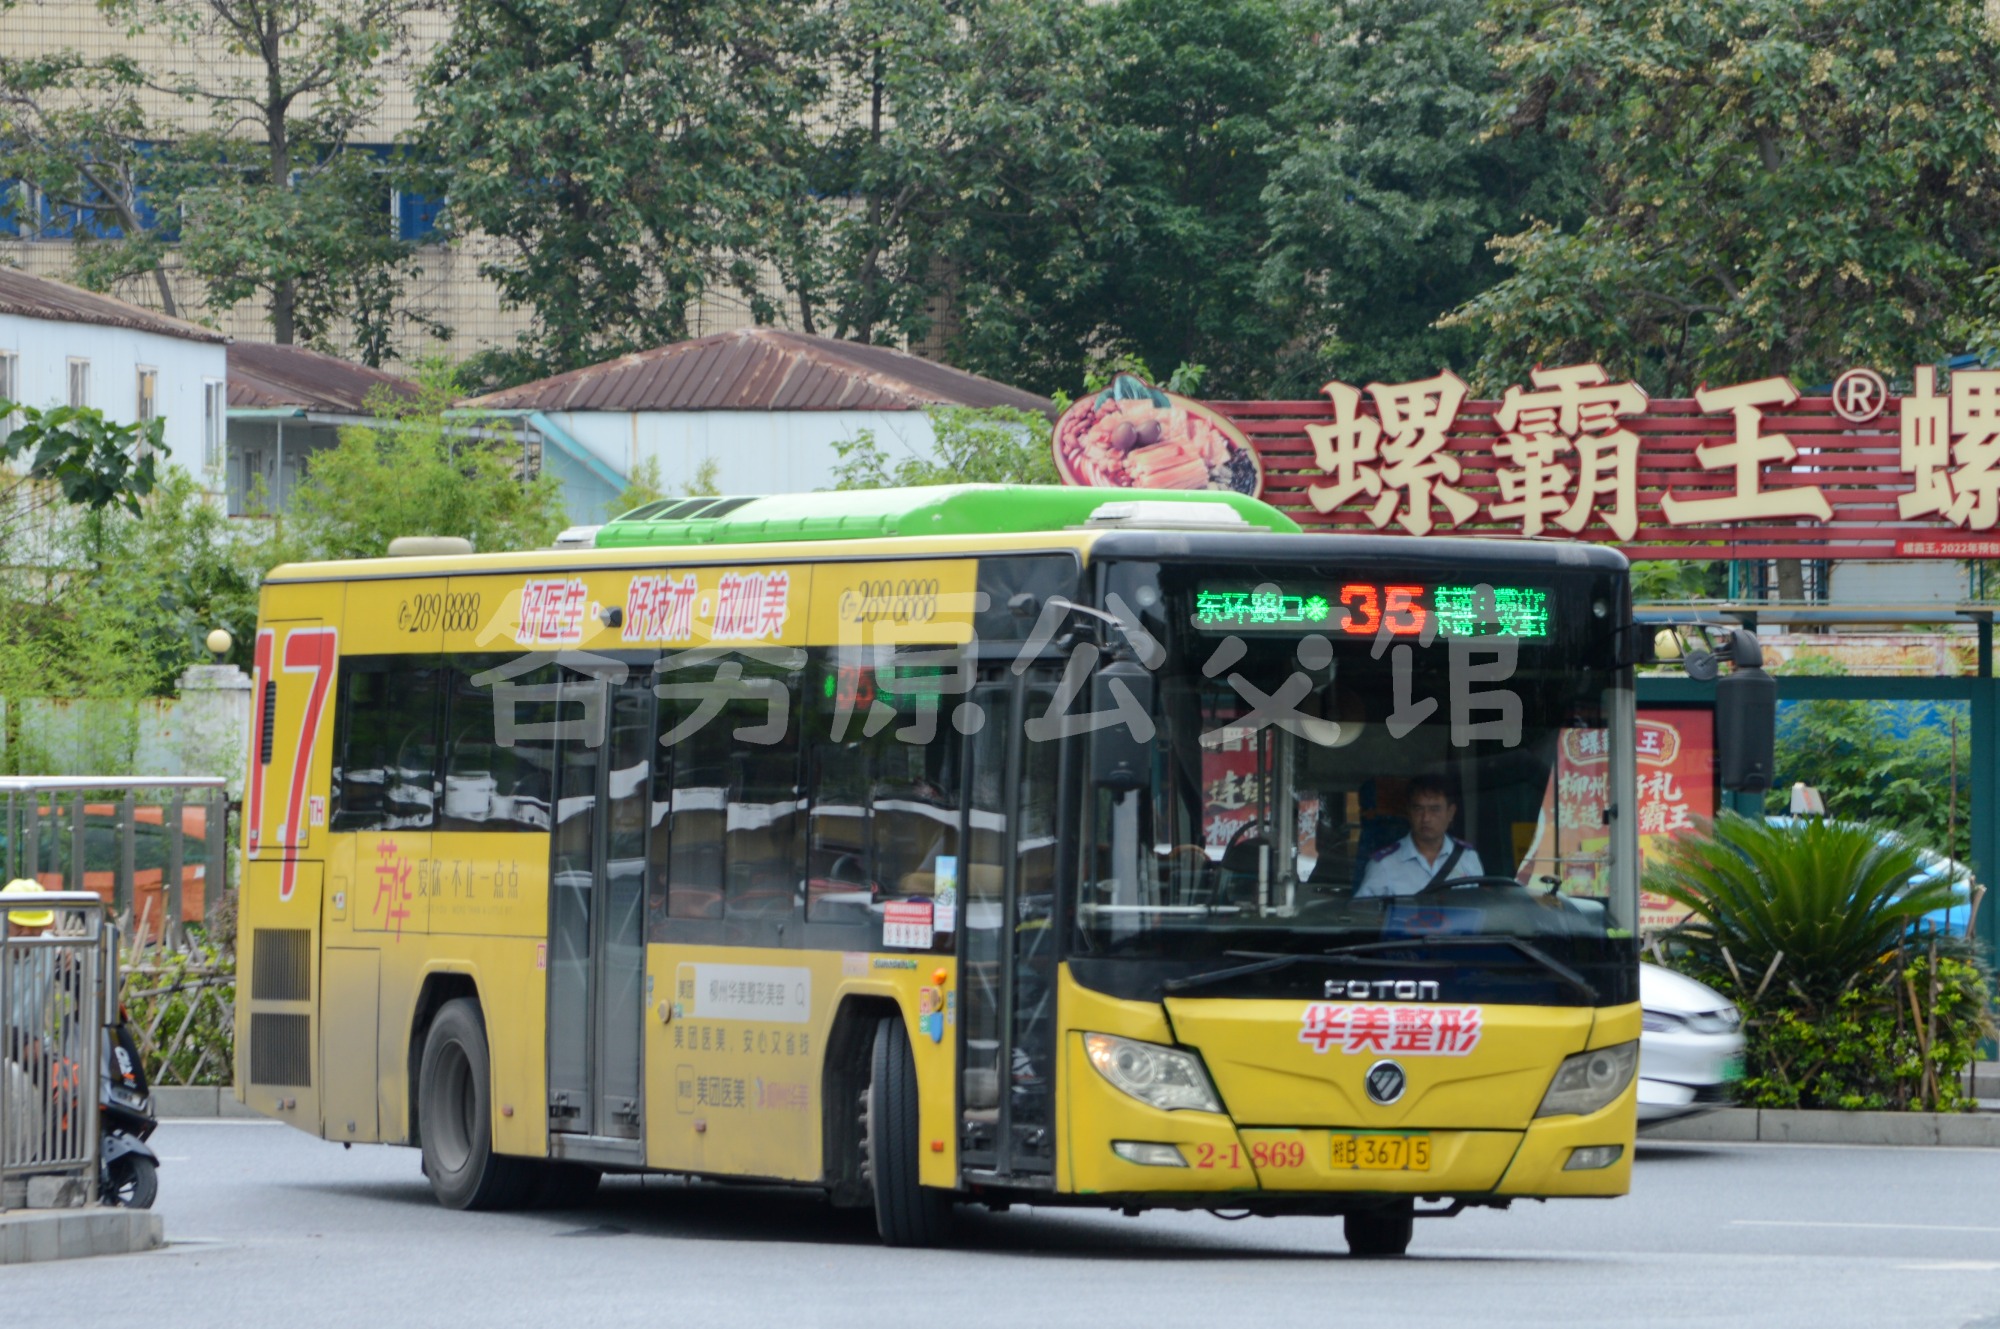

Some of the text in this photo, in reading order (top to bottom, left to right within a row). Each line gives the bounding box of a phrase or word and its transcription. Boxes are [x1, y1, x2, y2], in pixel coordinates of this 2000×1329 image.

[1304, 362, 1836, 541] 螺霸王
[1340, 584, 1426, 635] 35
[247, 626, 338, 902] 17
[1579, 731, 1661, 756] 螺王
[1551, 801, 1696, 833] 就选霸王
[1323, 979, 1440, 1000] FOTON
[1301, 1004, 1482, 1056] 华美整形
[697, 1076, 746, 1108] 美团医美
